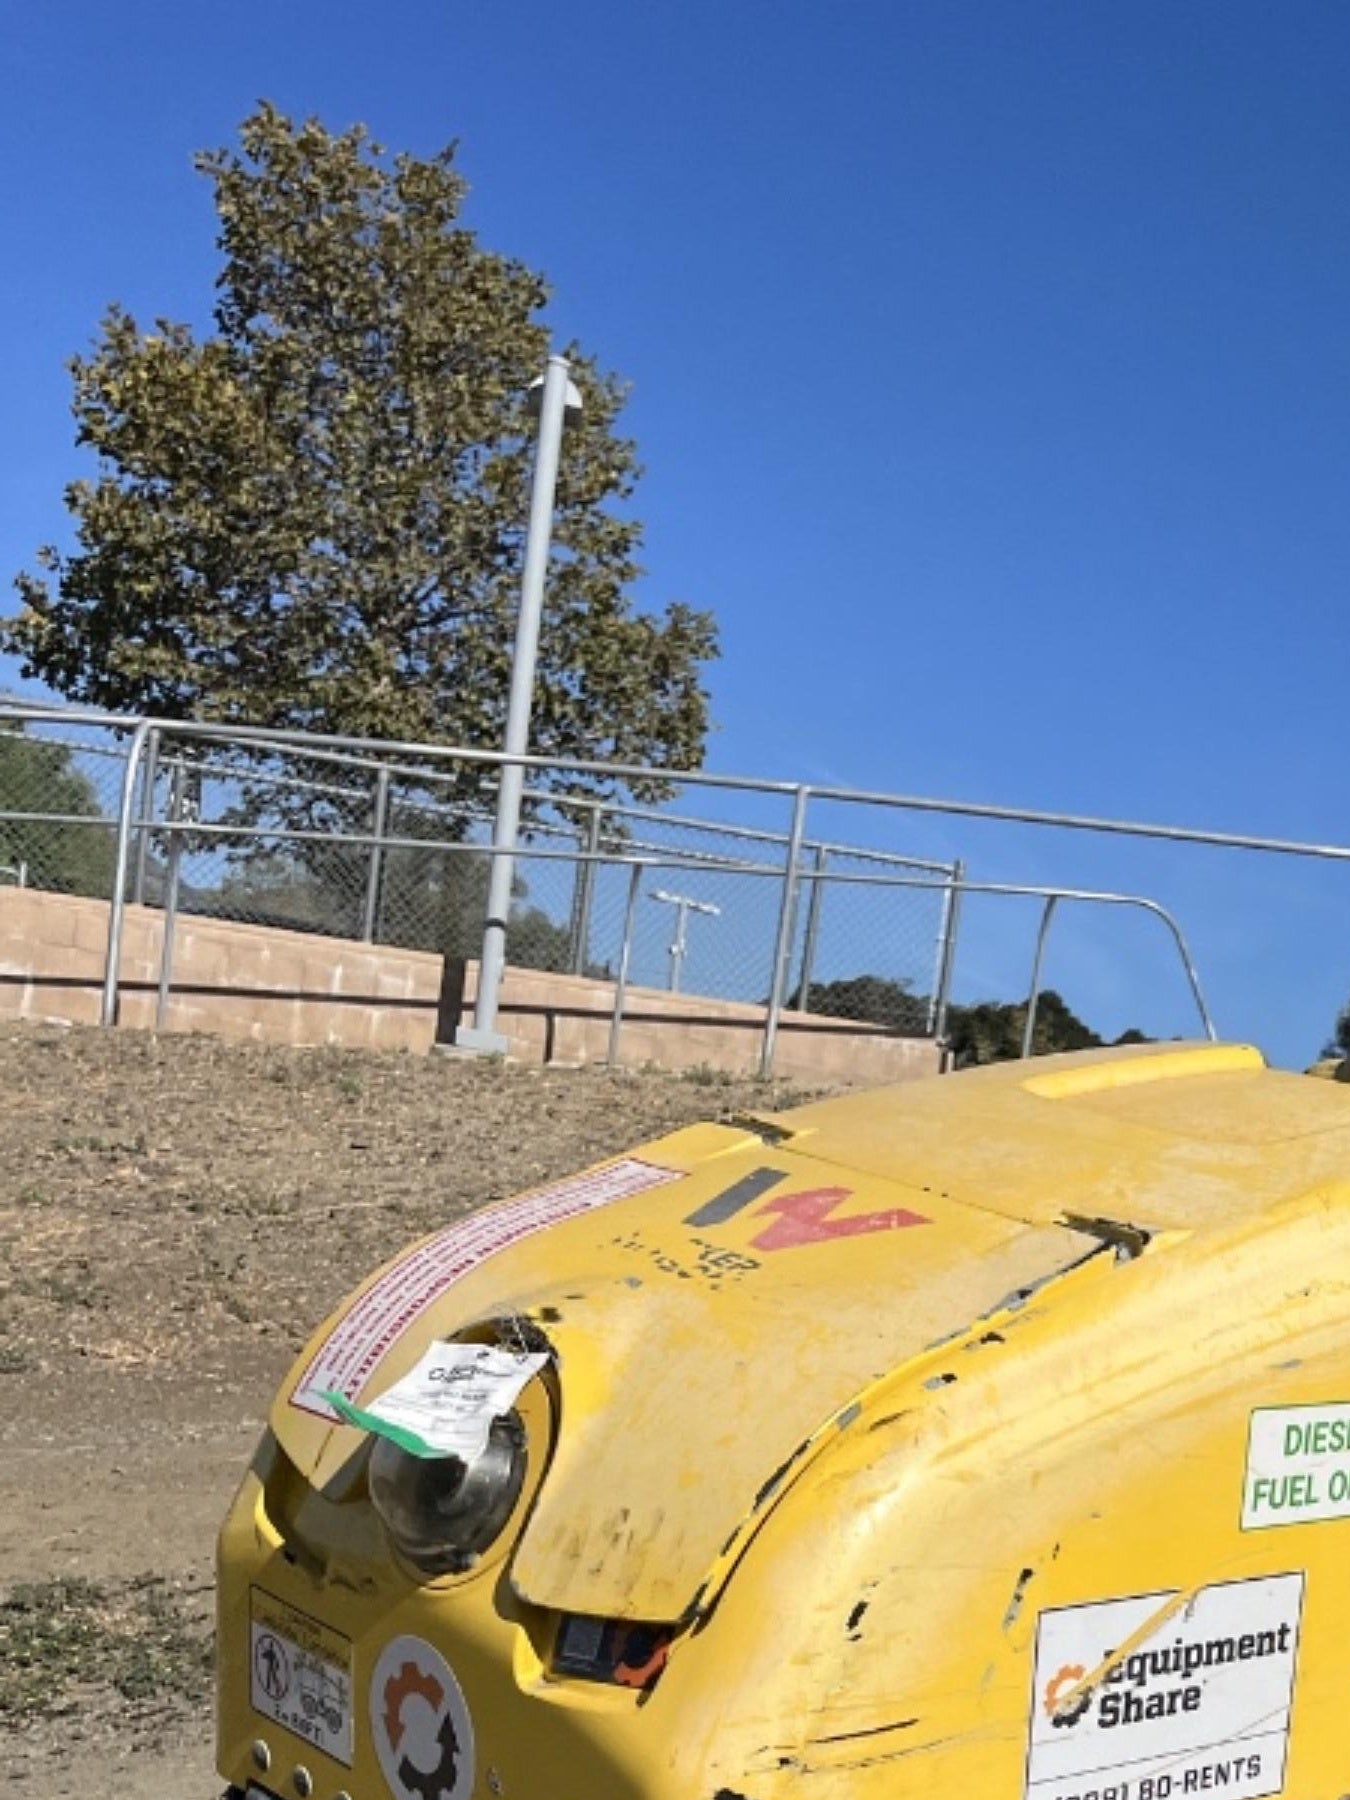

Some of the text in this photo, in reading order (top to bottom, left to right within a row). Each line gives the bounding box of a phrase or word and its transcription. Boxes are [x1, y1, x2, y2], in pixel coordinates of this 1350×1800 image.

[1252, 1474, 1320, 1513] FUEL
[1101, 1622, 1292, 1687] Equipment
[1098, 1684, 1202, 1729] Share
